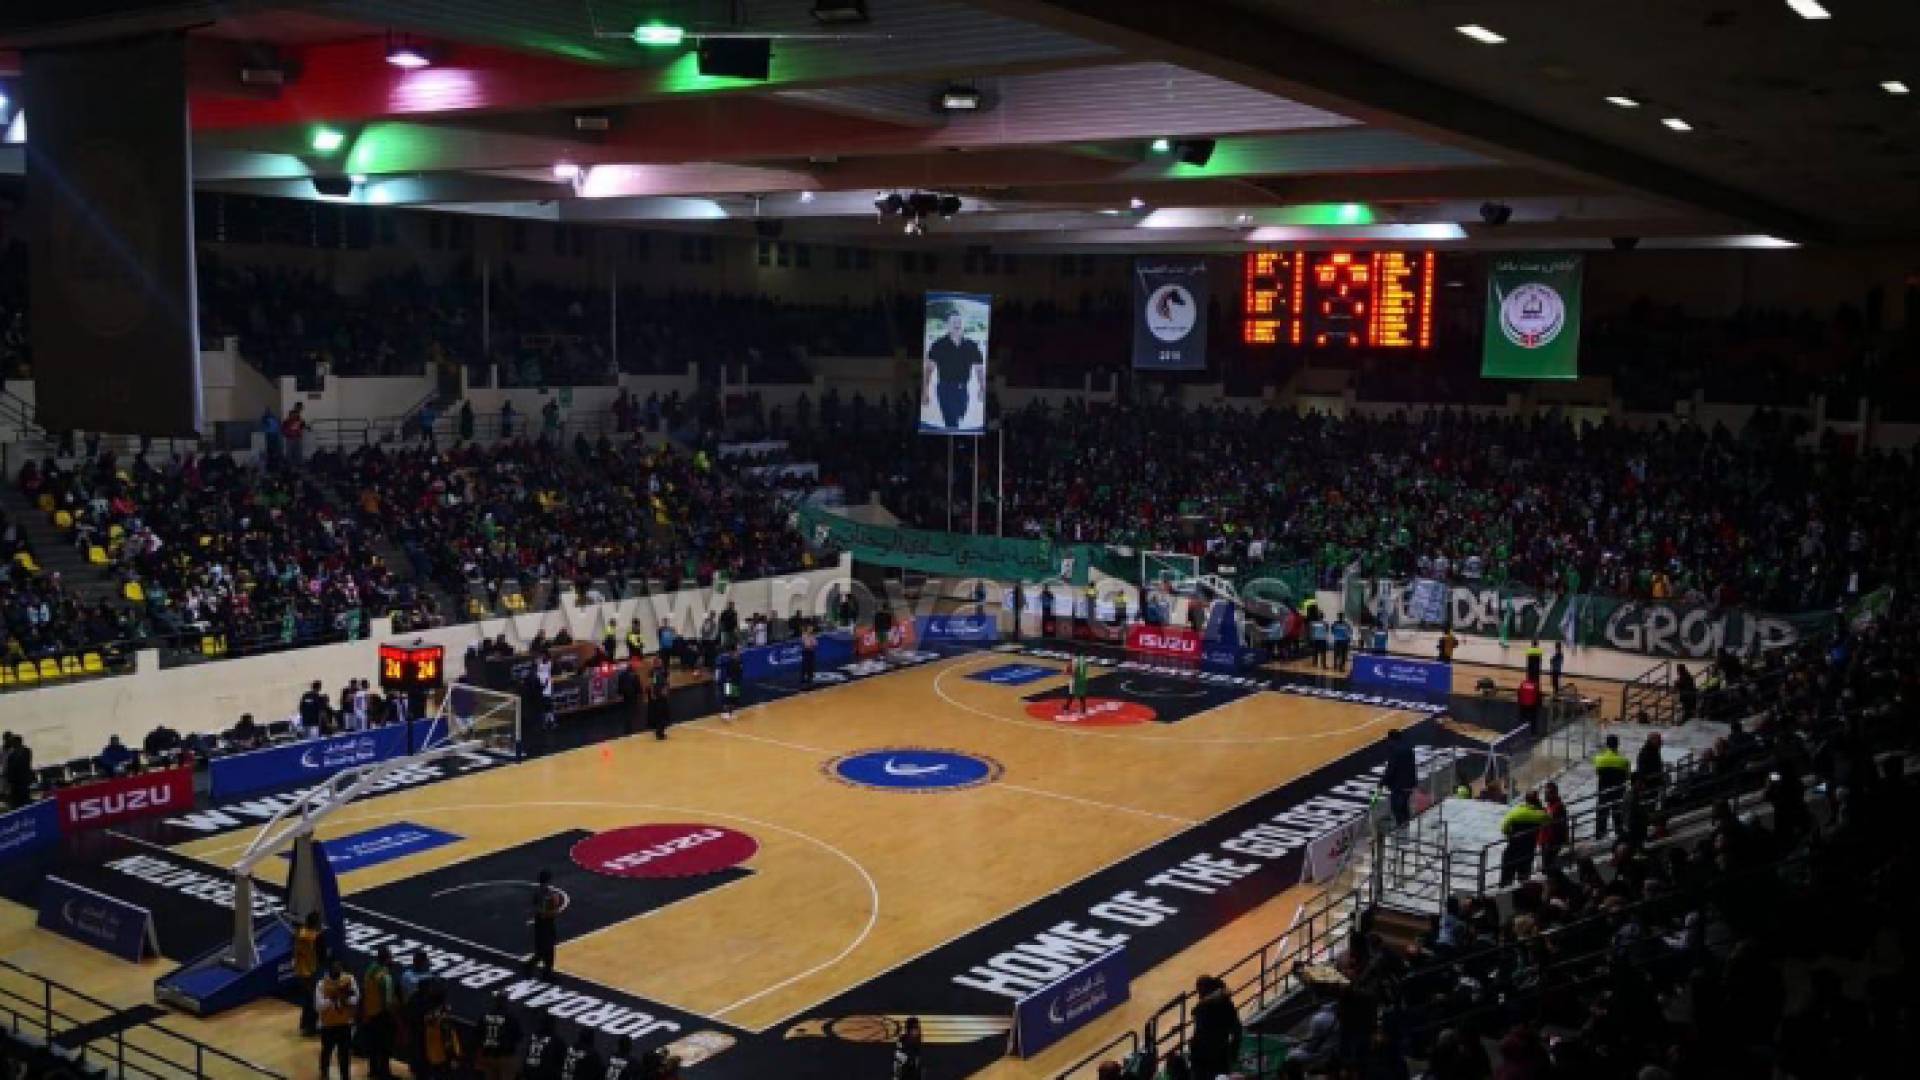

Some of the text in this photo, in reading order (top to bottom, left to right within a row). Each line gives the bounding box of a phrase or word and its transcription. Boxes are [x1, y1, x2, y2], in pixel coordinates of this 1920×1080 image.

[1606, 602, 1797, 656] GROUP
[69, 784, 172, 822] ISUZU
[602, 829, 724, 870] ISUZU
[952, 920, 1131, 998] HOME
[1088, 890, 1179, 927] OF
[1144, 853, 1262, 895] THE
[1220, 795, 1371, 858] GOLDEN
[505, 978, 682, 1041] JORDAN
